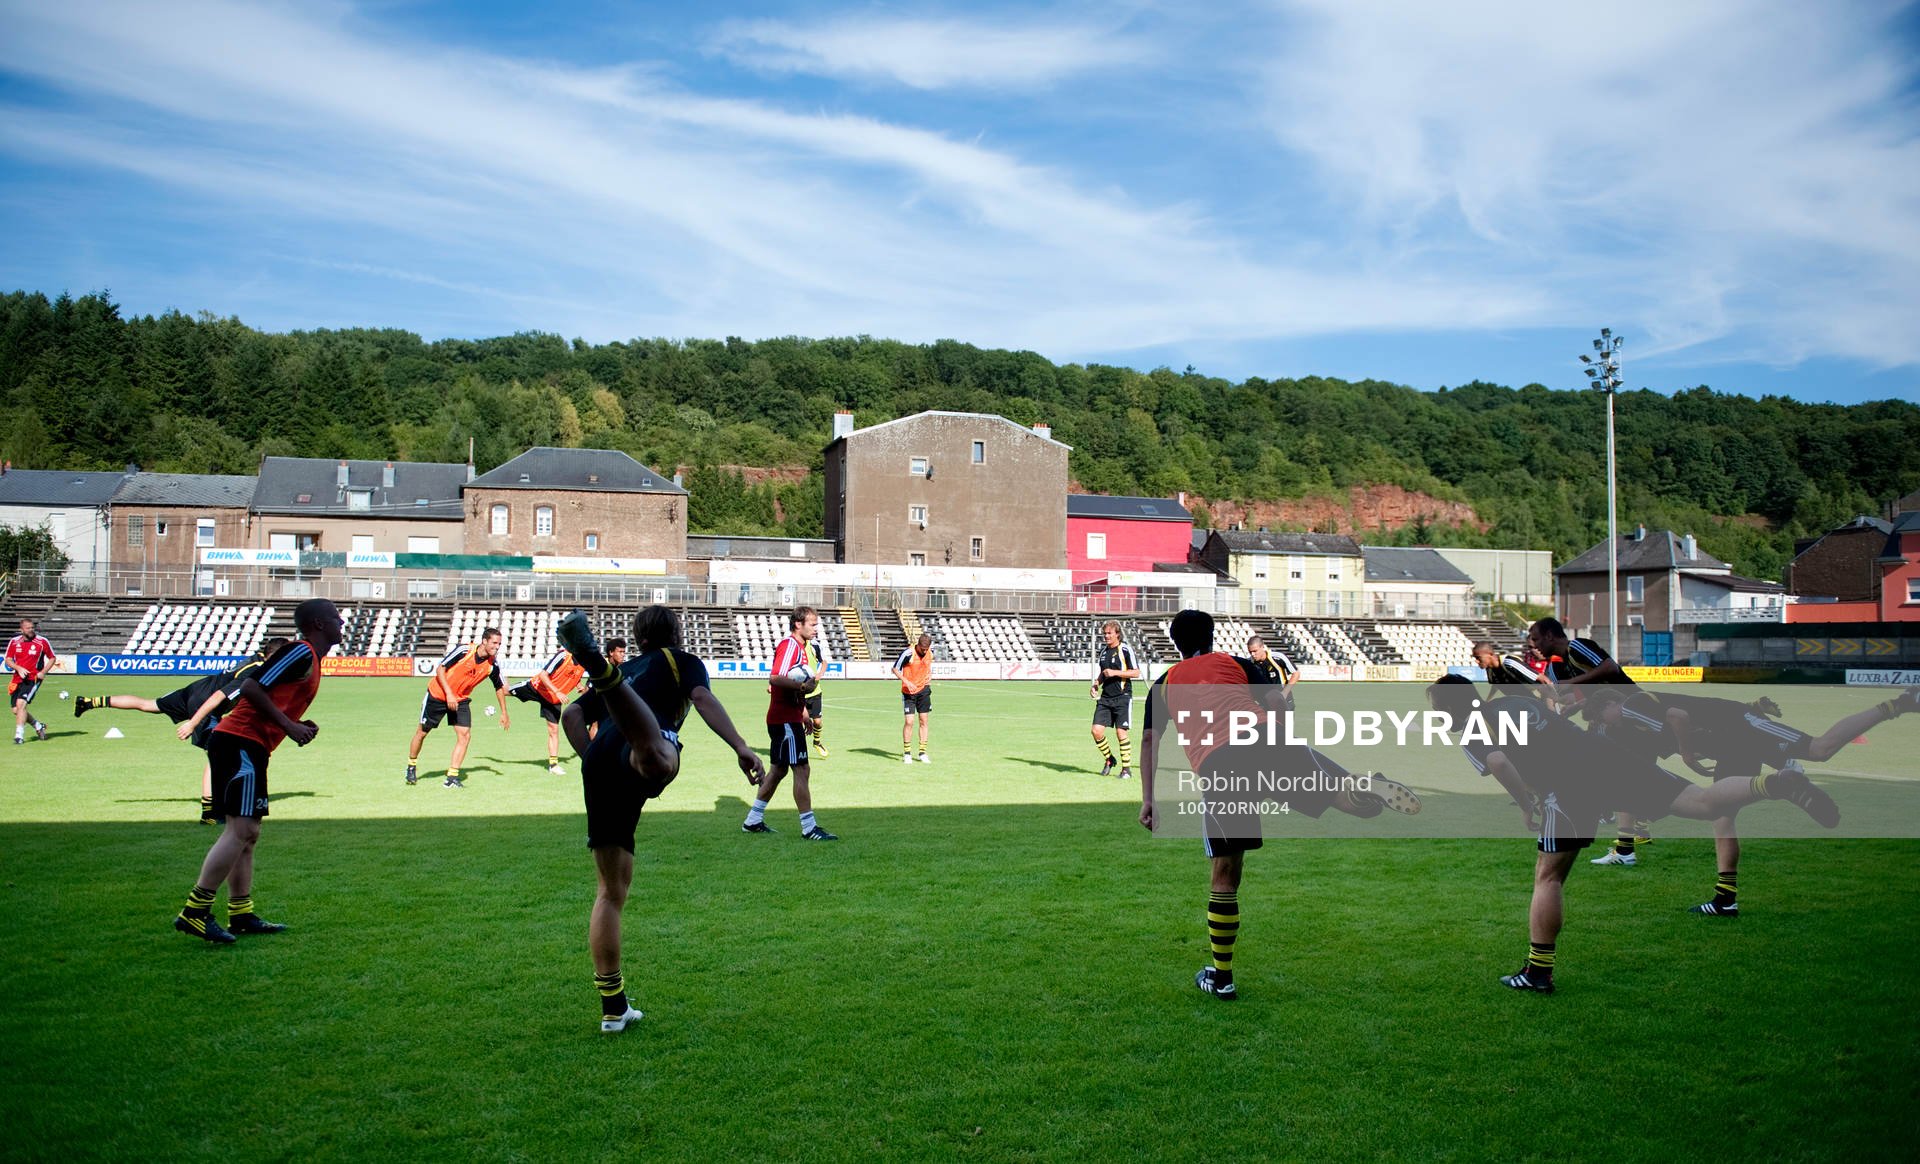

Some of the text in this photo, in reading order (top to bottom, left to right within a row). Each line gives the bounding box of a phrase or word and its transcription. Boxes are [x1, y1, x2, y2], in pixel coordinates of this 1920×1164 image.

[111, 659, 175, 670] VOYAGES
[321, 658, 372, 667] UTO-ECOLE
[930, 666, 957, 675] ECOR
[1366, 667, 1399, 679] RENAULT
[1662, 668, 1694, 677] OLINGER
